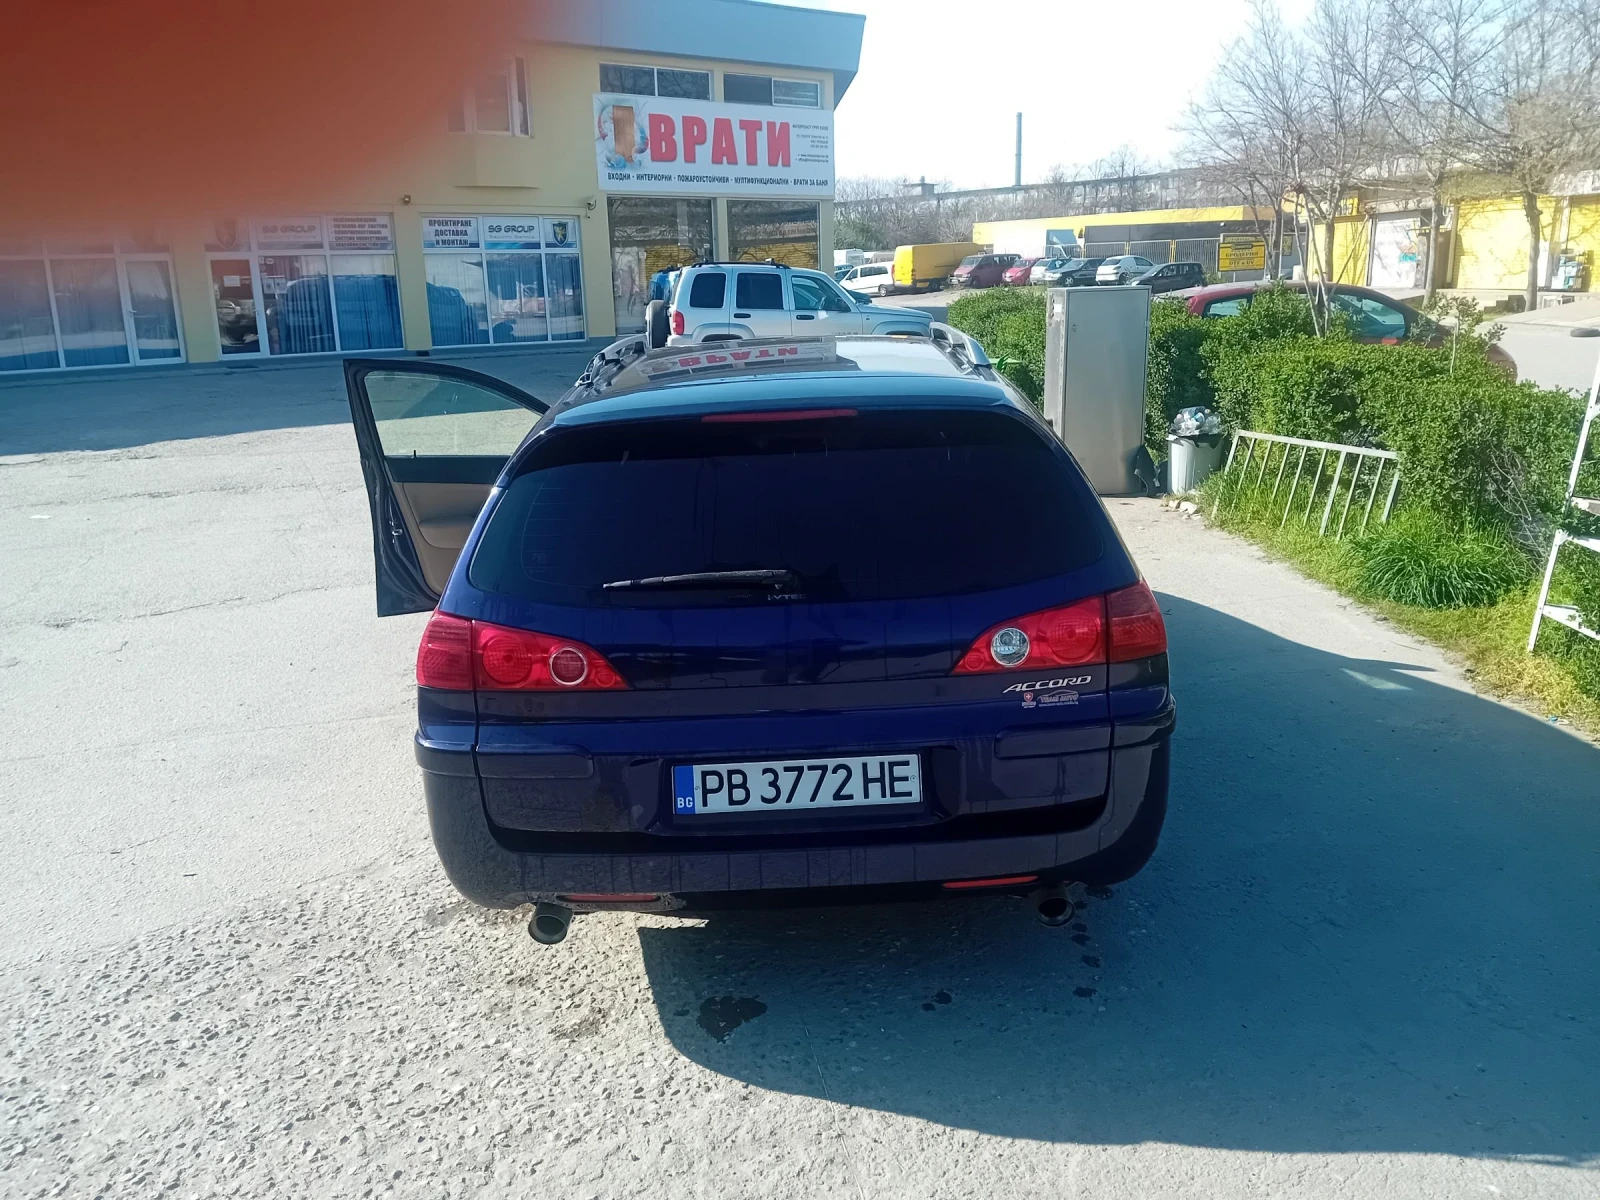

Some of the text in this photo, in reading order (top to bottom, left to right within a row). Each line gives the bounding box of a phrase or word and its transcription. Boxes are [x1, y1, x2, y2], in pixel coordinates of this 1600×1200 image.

[648, 113, 791, 168] ВРАТИ
[607, 172, 631, 181] ВХОДНИ
[636, 173, 672, 182] ИНТЕРИОРНИ
[677, 174, 729, 183] ПОЖАРОУСТОЙЧИВИ
[793, 178, 808, 186] ВРАТИ
[816, 179, 828, 187] БАНЯ
[428, 219, 472, 228] ПРОЕКТИРАНЕ
[280, 224, 316, 234] GROUP
[434, 229, 469, 238] ДОСТАВКА
[488, 224, 535, 234] SG GROUP
[435, 238, 469, 246] И МОНТАЖ
[1002, 675, 1092, 694] ACCORD
[701, 760, 913, 808] PB 3772 HE
[677, 796, 694, 809] BG
